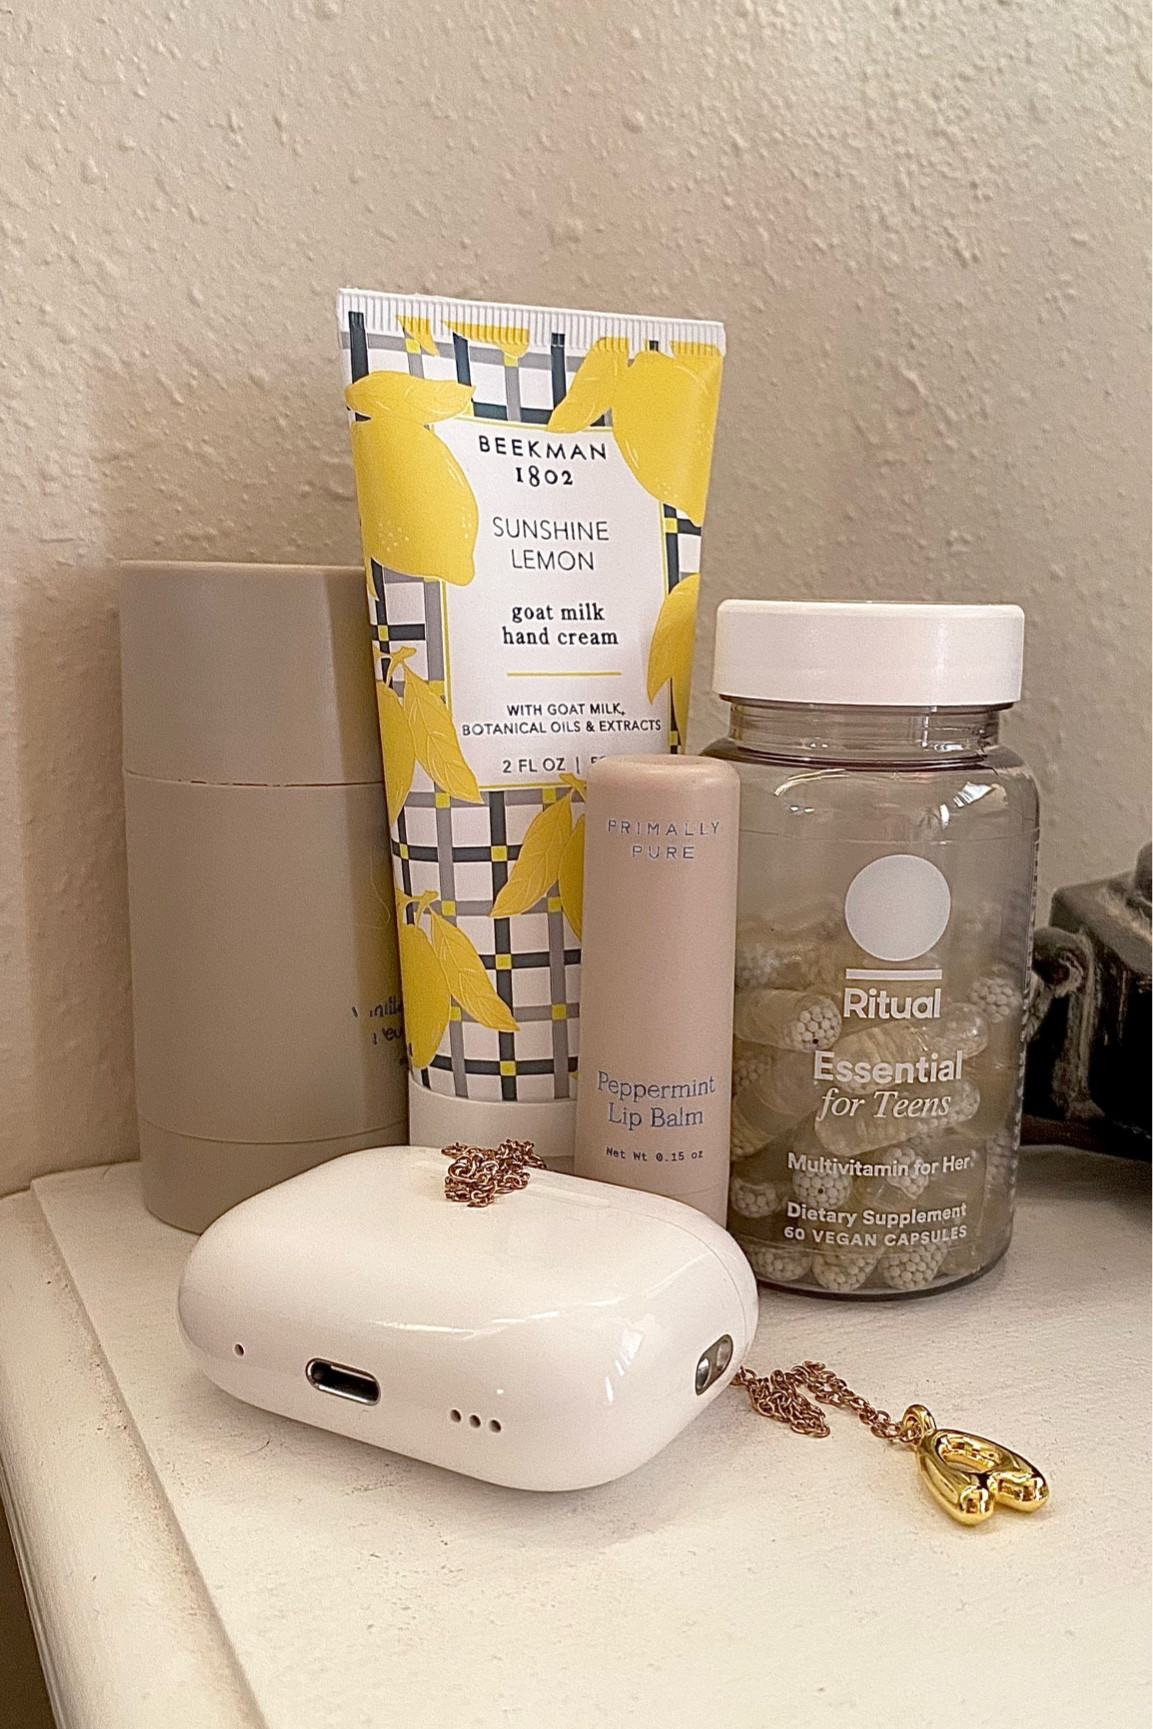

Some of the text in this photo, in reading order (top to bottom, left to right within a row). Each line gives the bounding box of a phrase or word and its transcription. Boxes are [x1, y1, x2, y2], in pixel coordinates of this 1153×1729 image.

[478, 434, 607, 461] BEEKMAN
[515, 465, 574, 488] 1802
[492, 515, 610, 541] SUNSHINE
[510, 548, 595, 572] LEMON
[511, 602, 606, 624] goat milk
[501, 626, 619, 645] hand cream
[506, 702, 626, 716] WITH GOAT MILK,
[462, 719, 662, 737] BOTANICAL OILS & EXTRACTS
[502, 757, 566, 773] 2 FL OZ
[608, 818, 721, 837] PRIMALLY
[632, 844, 696, 860] PURE
[843, 987, 942, 1020] Ritual
[813, 1050, 963, 1084] Essential
[597, 1069, 716, 1103] Peppermint
[816, 1087, 952, 1122] for Teens
[608, 1102, 705, 1131] Lip Balm
[606, 1146, 704, 1163] Net Wt 0.15 oz
[787, 1152, 971, 1177] Multivitamin for Her
[787, 1202, 967, 1228] Dietary Supplement
[783, 1224, 968, 1247] 60 VEGAN CAPSULES
